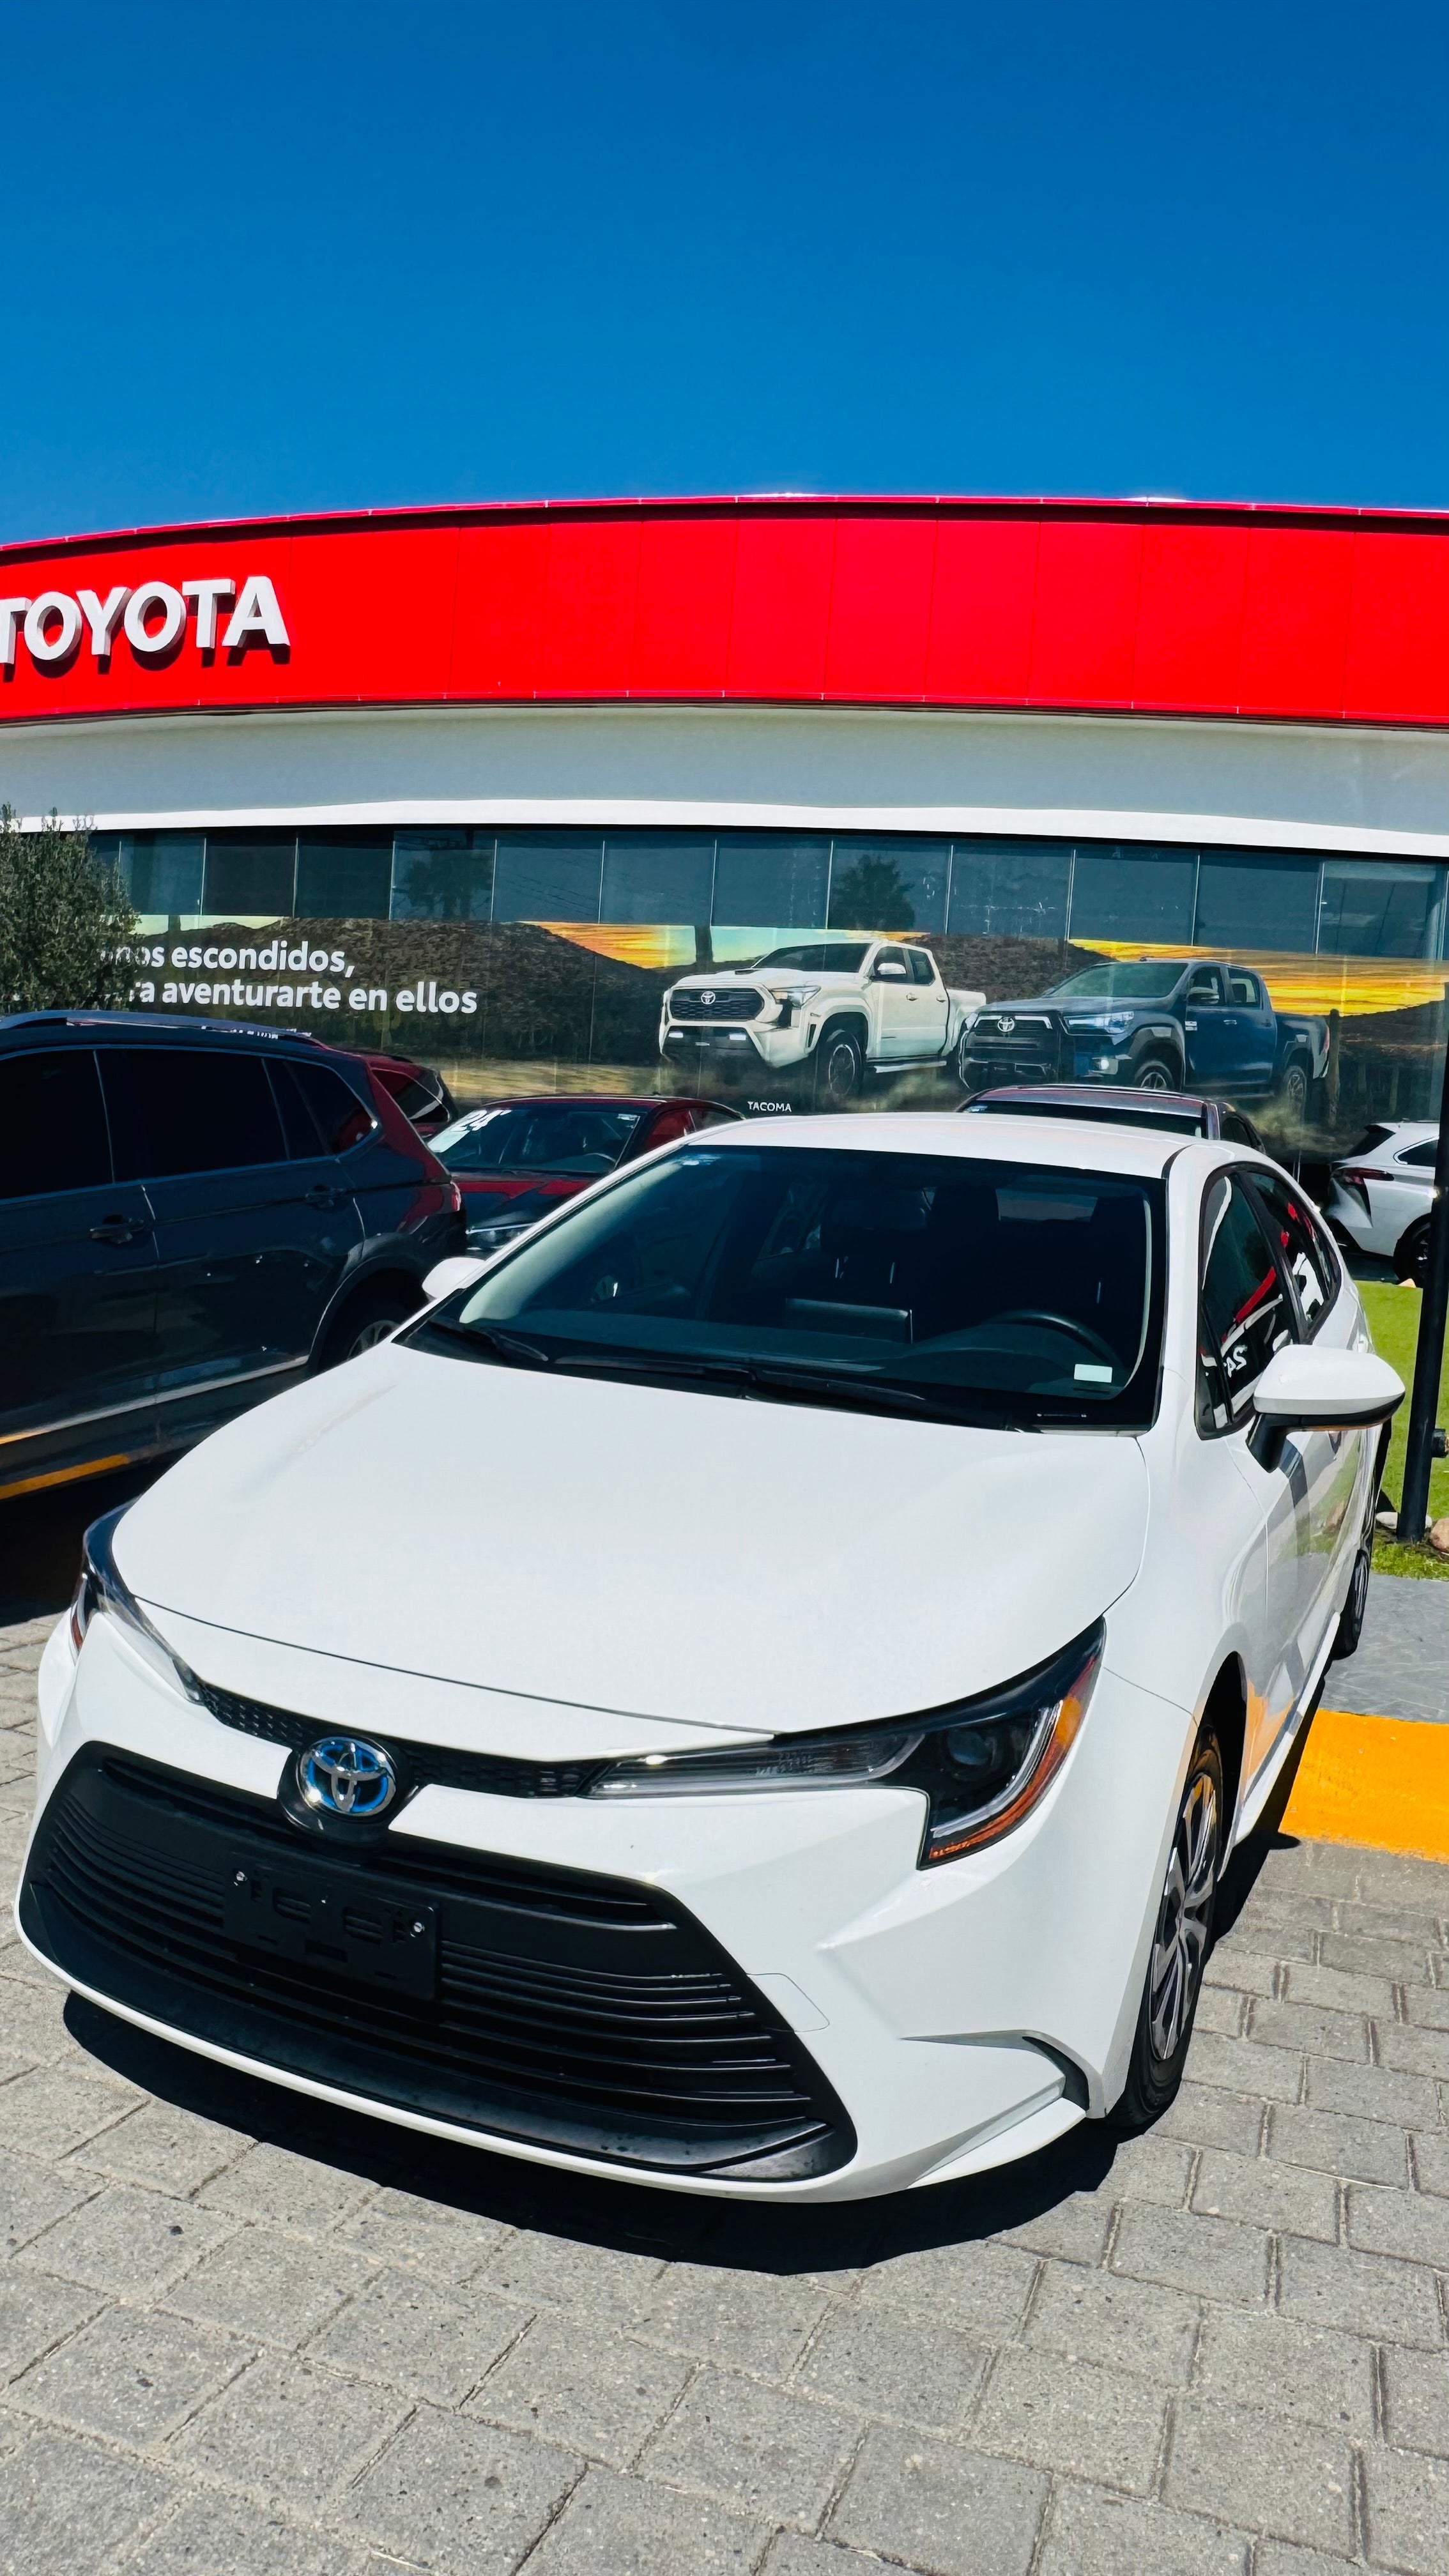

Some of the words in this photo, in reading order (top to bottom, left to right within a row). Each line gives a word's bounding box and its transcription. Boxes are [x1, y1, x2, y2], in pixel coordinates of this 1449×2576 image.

[0, 576, 291, 664] TOYOTA
[171, 940, 355, 978] escondidos,
[162, 979, 341, 1009] aventurarte
[348, 987, 387, 1011] en
[395, 981, 477, 1015] ellos
[747, 1101, 792, 1112] TACOMA
